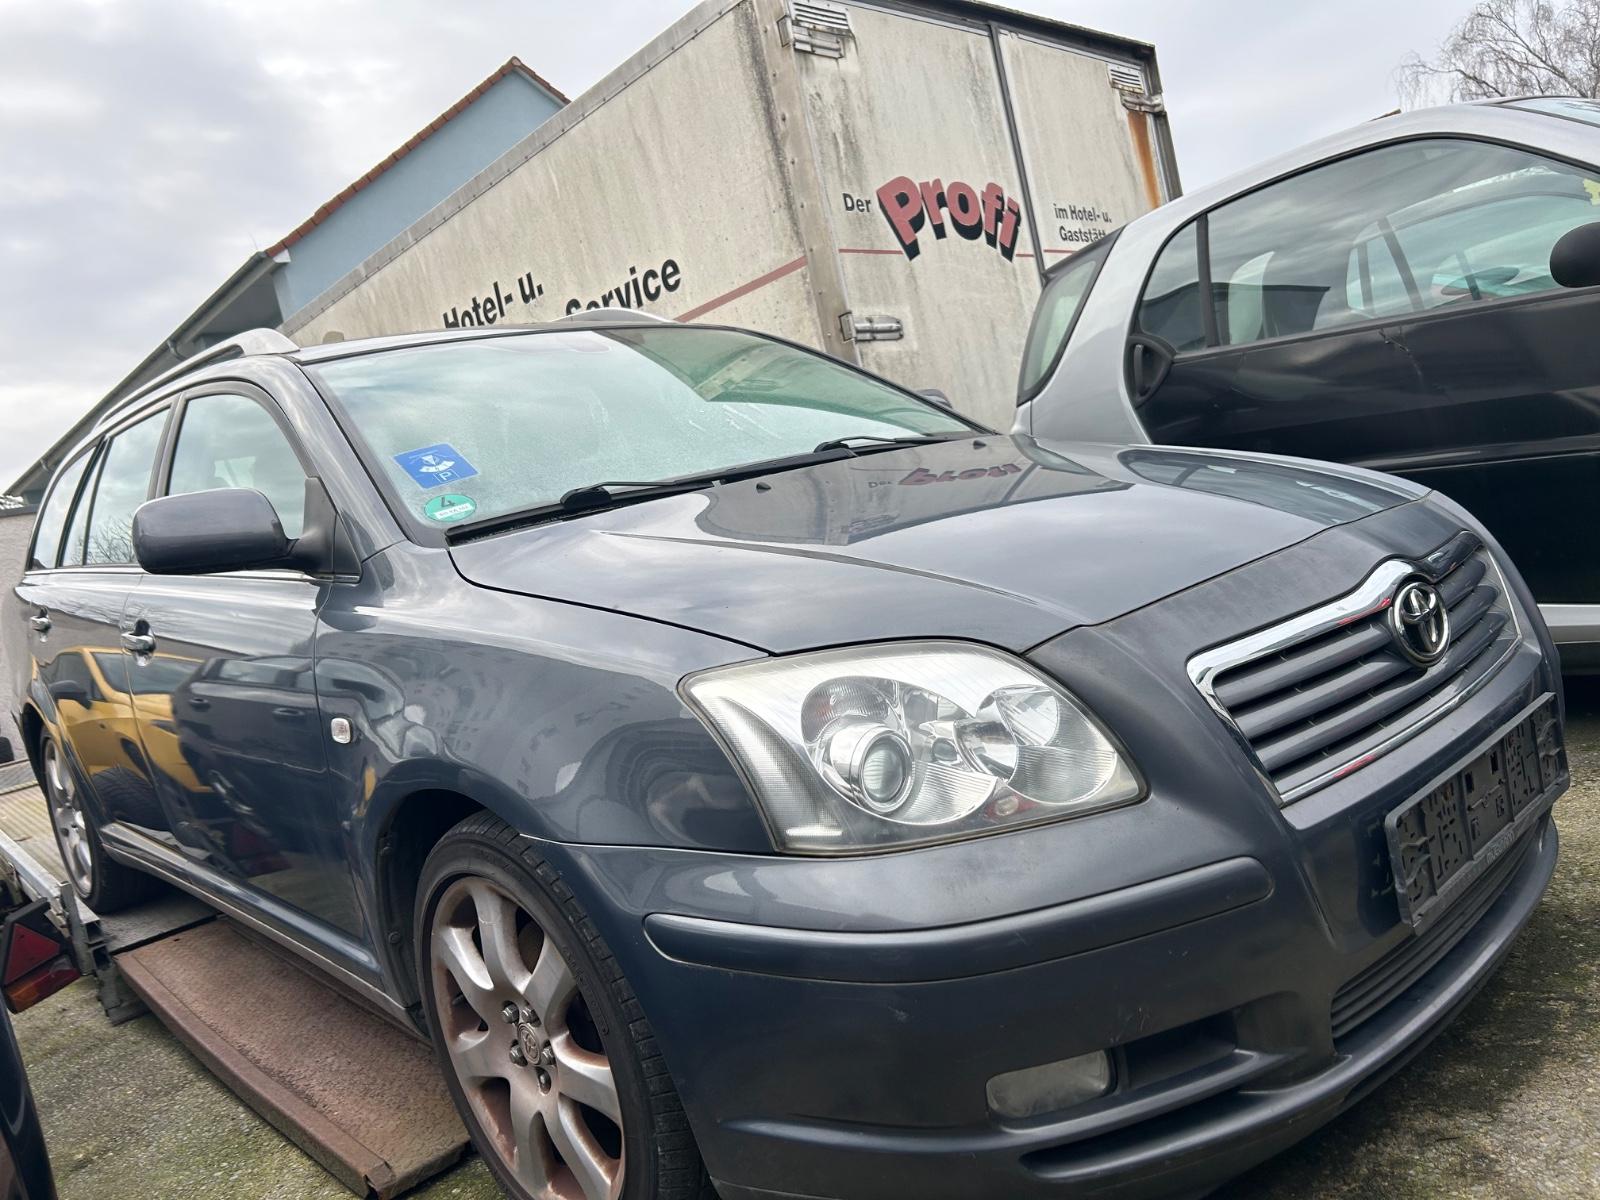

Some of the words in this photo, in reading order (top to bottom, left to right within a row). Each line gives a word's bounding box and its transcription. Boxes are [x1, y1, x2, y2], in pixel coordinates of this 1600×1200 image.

[843, 193, 871, 213] Der
[876, 176, 1021, 262] Profi
[1053, 203, 1069, 219] im
[1069, 205, 1101, 221] Hotel-
[1102, 212, 1112, 223] u.
[518, 272, 544, 304] u.
[565, 259, 681, 316] rvice
